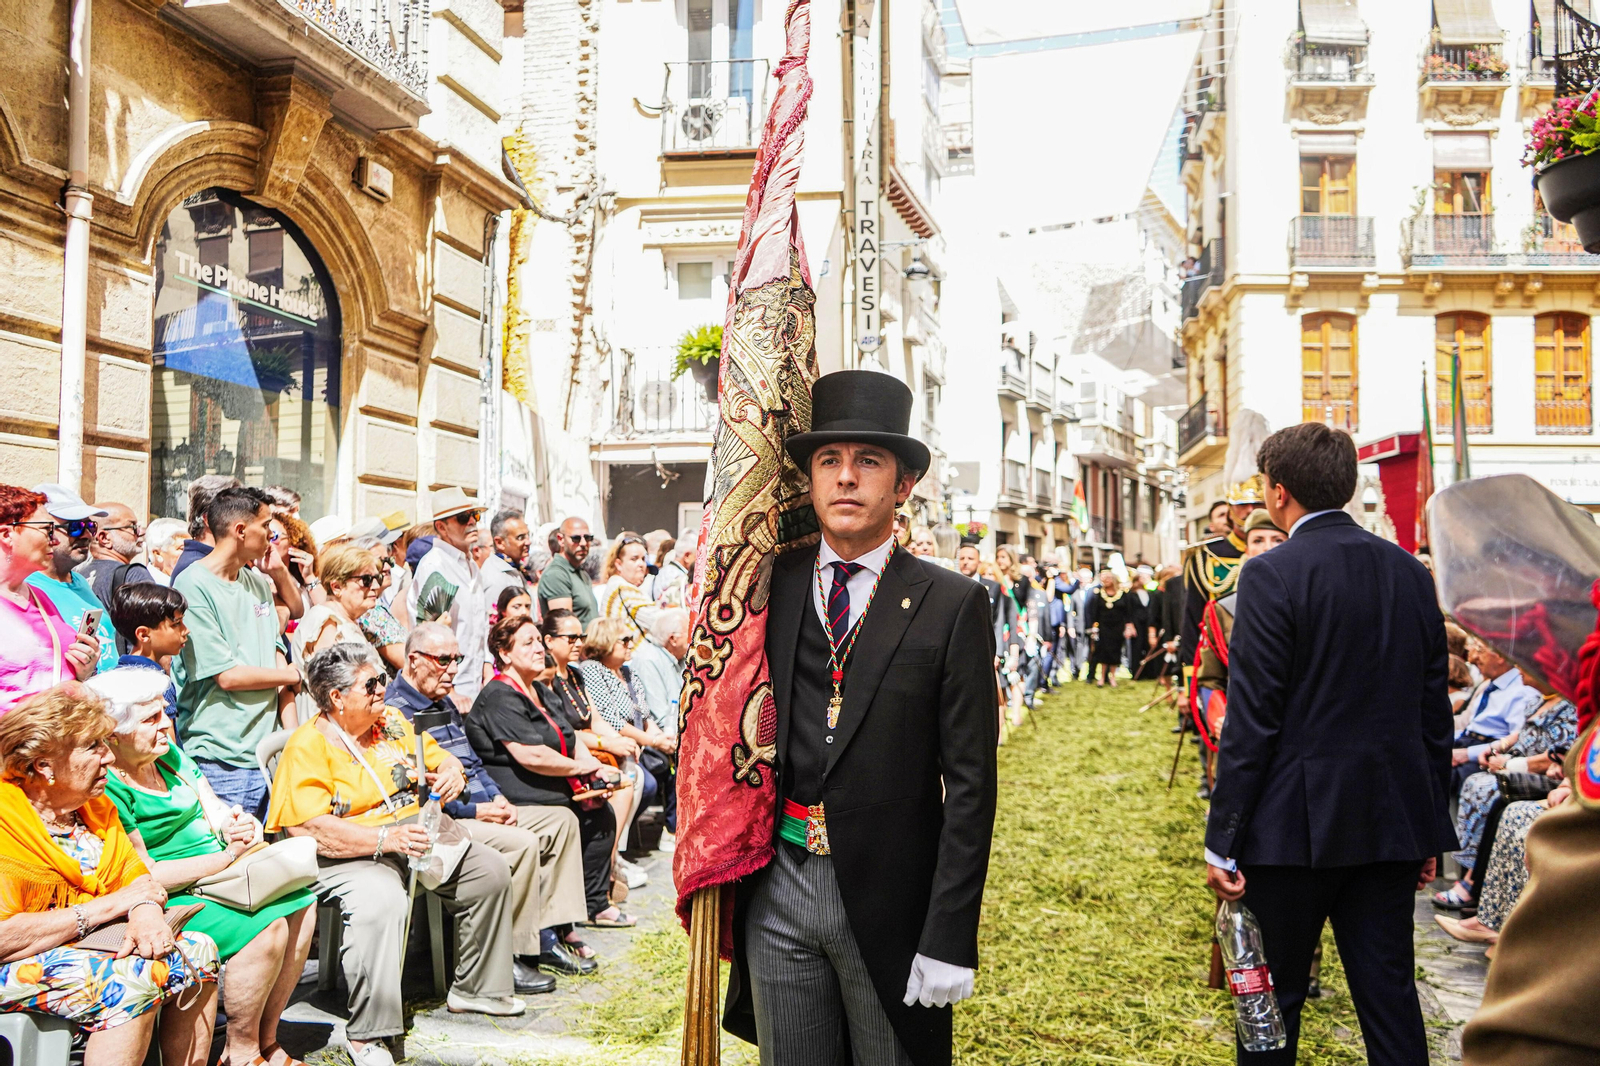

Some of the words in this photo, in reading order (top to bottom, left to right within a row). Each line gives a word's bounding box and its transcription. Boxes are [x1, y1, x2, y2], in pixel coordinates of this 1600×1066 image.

[174, 250, 213, 284] The
[214, 264, 269, 304] Phone
[269, 285, 318, 321] House
[859, 200, 877, 330] TRAVESI
